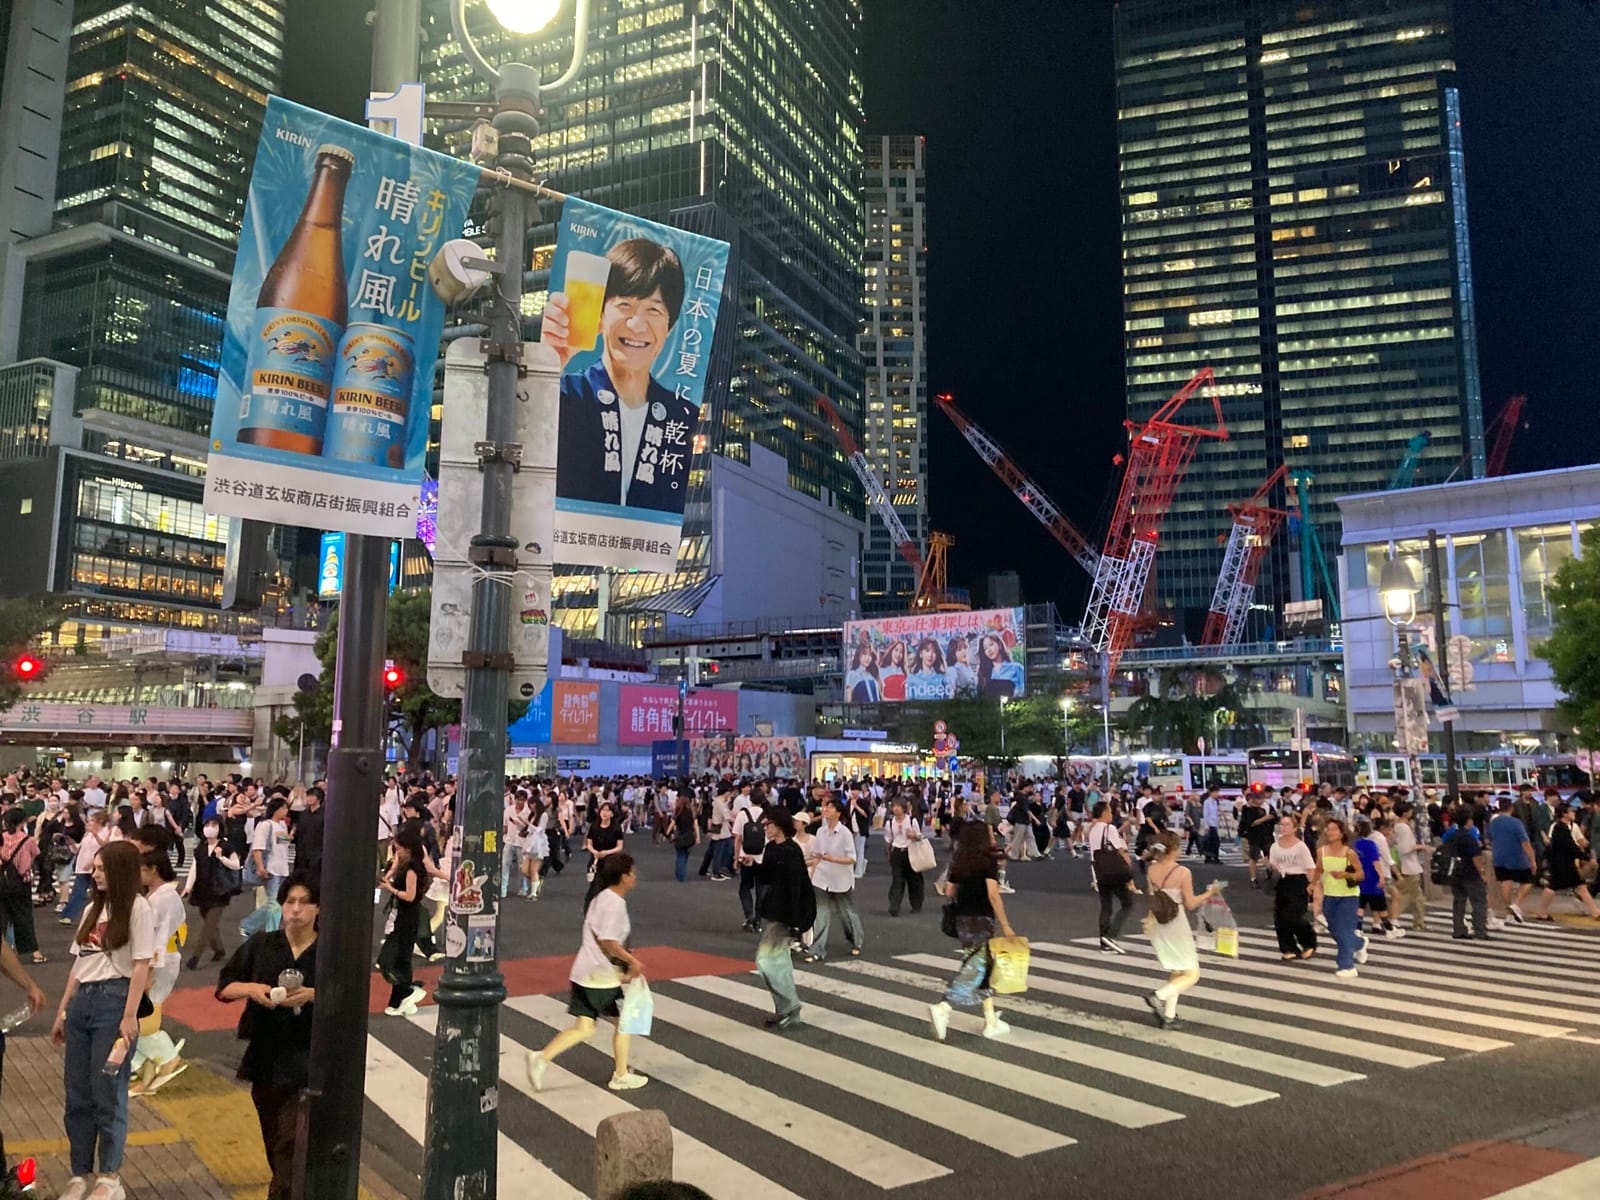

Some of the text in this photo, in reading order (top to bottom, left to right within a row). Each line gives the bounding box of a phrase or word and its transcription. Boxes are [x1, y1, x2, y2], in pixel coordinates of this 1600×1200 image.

[275, 127, 312, 148] KIRIN
[569, 222, 598, 238] KIRIN
[350, 175, 421, 317] 晴れ風
[396, 188, 447, 322] キリンビール
[259, 372, 326, 394] KIRIN BEER
[658, 266, 712, 490] 日本の夏に、乾杯。
[263, 398, 313, 423] 晴れ風
[339, 391, 402, 412] KIRIN BEER
[342, 416, 391, 440] 晴れ風
[213, 476, 412, 519] 渋谷道玄坂商店街振興組合
[21, 705, 148, 725] 渋谷駅
